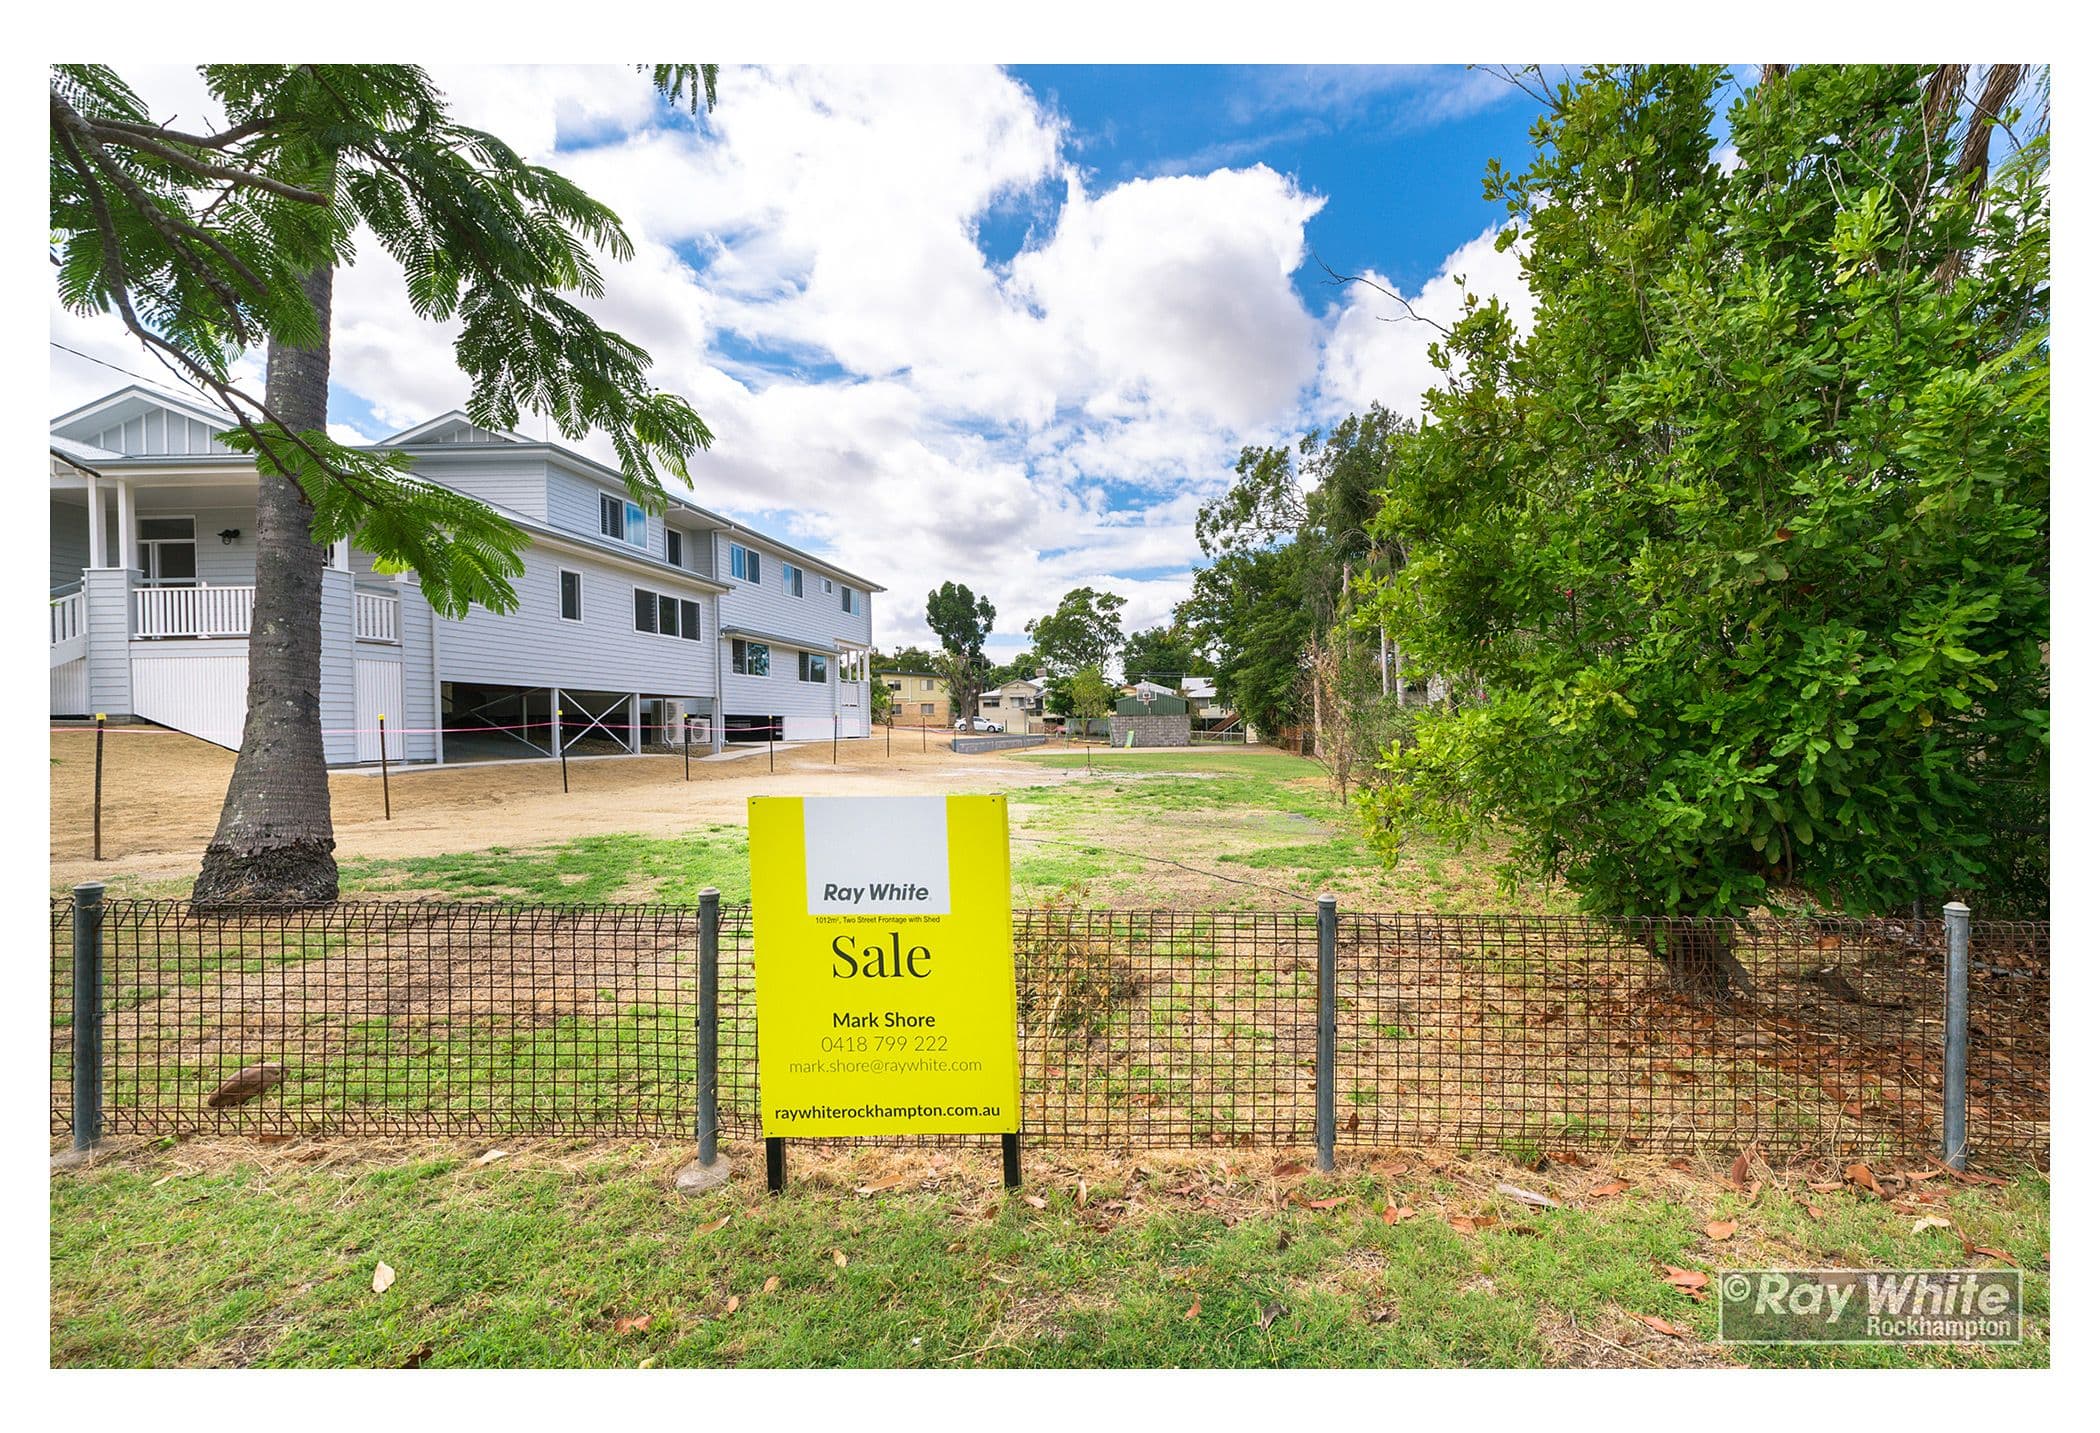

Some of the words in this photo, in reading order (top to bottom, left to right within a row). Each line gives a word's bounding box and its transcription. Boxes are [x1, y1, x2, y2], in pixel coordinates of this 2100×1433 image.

[823, 883, 866, 905] Ray
[868, 883, 930, 902] White
[857, 916, 877, 924] Street
[878, 916, 907, 925] Frontage
[832, 932, 932, 980] Sale
[833, 1011, 880, 1029] Mark
[884, 1011, 936, 1028] Shore
[821, 1036, 868, 1053] 0418
[874, 1036, 908, 1053] 799
[914, 1036, 948, 1052] 222
[789, 1058, 983, 1075] mark.shore@raywhite.com
[775, 1103, 1001, 1122] raywhiterockhampton.com.au
